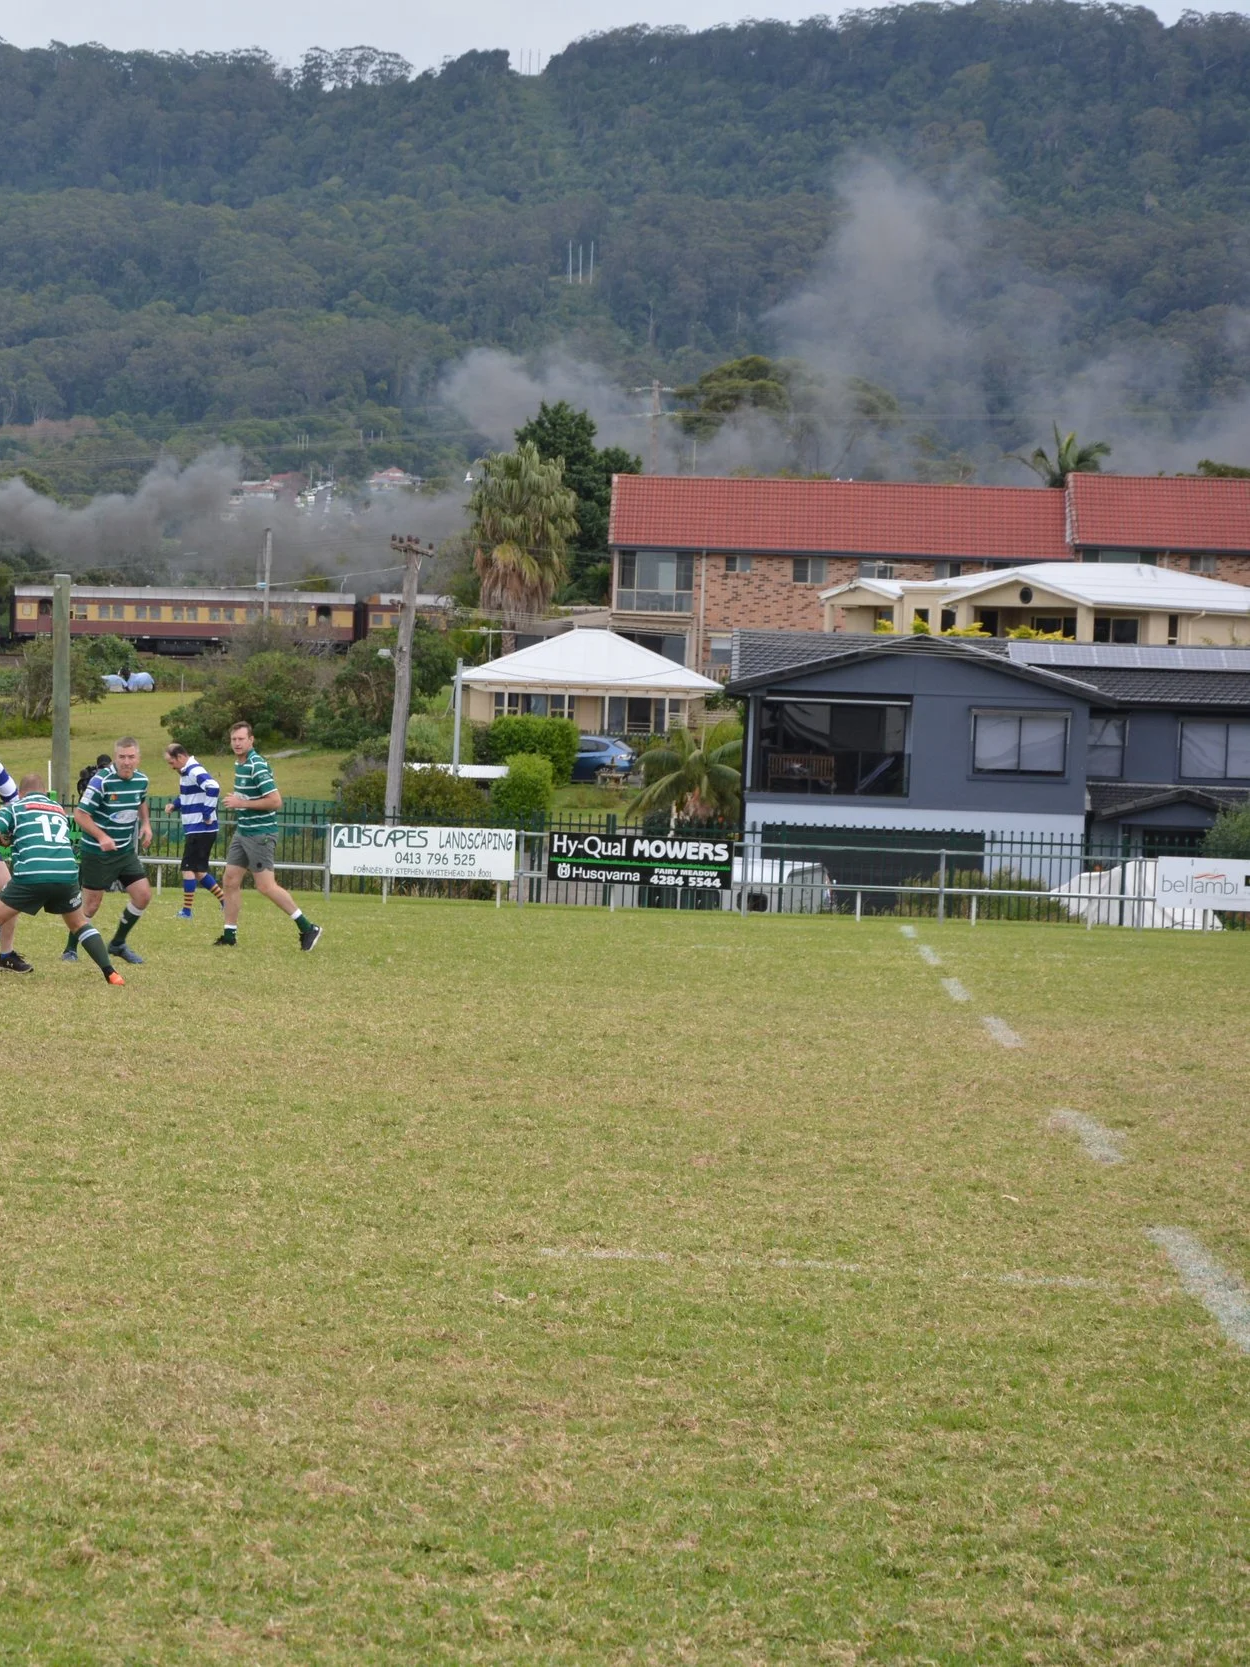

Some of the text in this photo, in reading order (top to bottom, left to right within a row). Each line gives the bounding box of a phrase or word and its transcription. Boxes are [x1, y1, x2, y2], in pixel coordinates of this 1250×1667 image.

[34, 814, 71, 844] 12
[438, 830, 513, 851] LANDSCAPING
[552, 834, 729, 862] Hy-Qual MOWERS
[394, 851, 476, 867] 0413 796 525
[395, 867, 424, 876] STEPHEN
[426, 869, 465, 877] WHITEHEAD
[572, 866, 640, 882] Husqvarna
[654, 868, 718, 878] FAIRY MEADOW
[649, 875, 722, 888] 4284 5544
